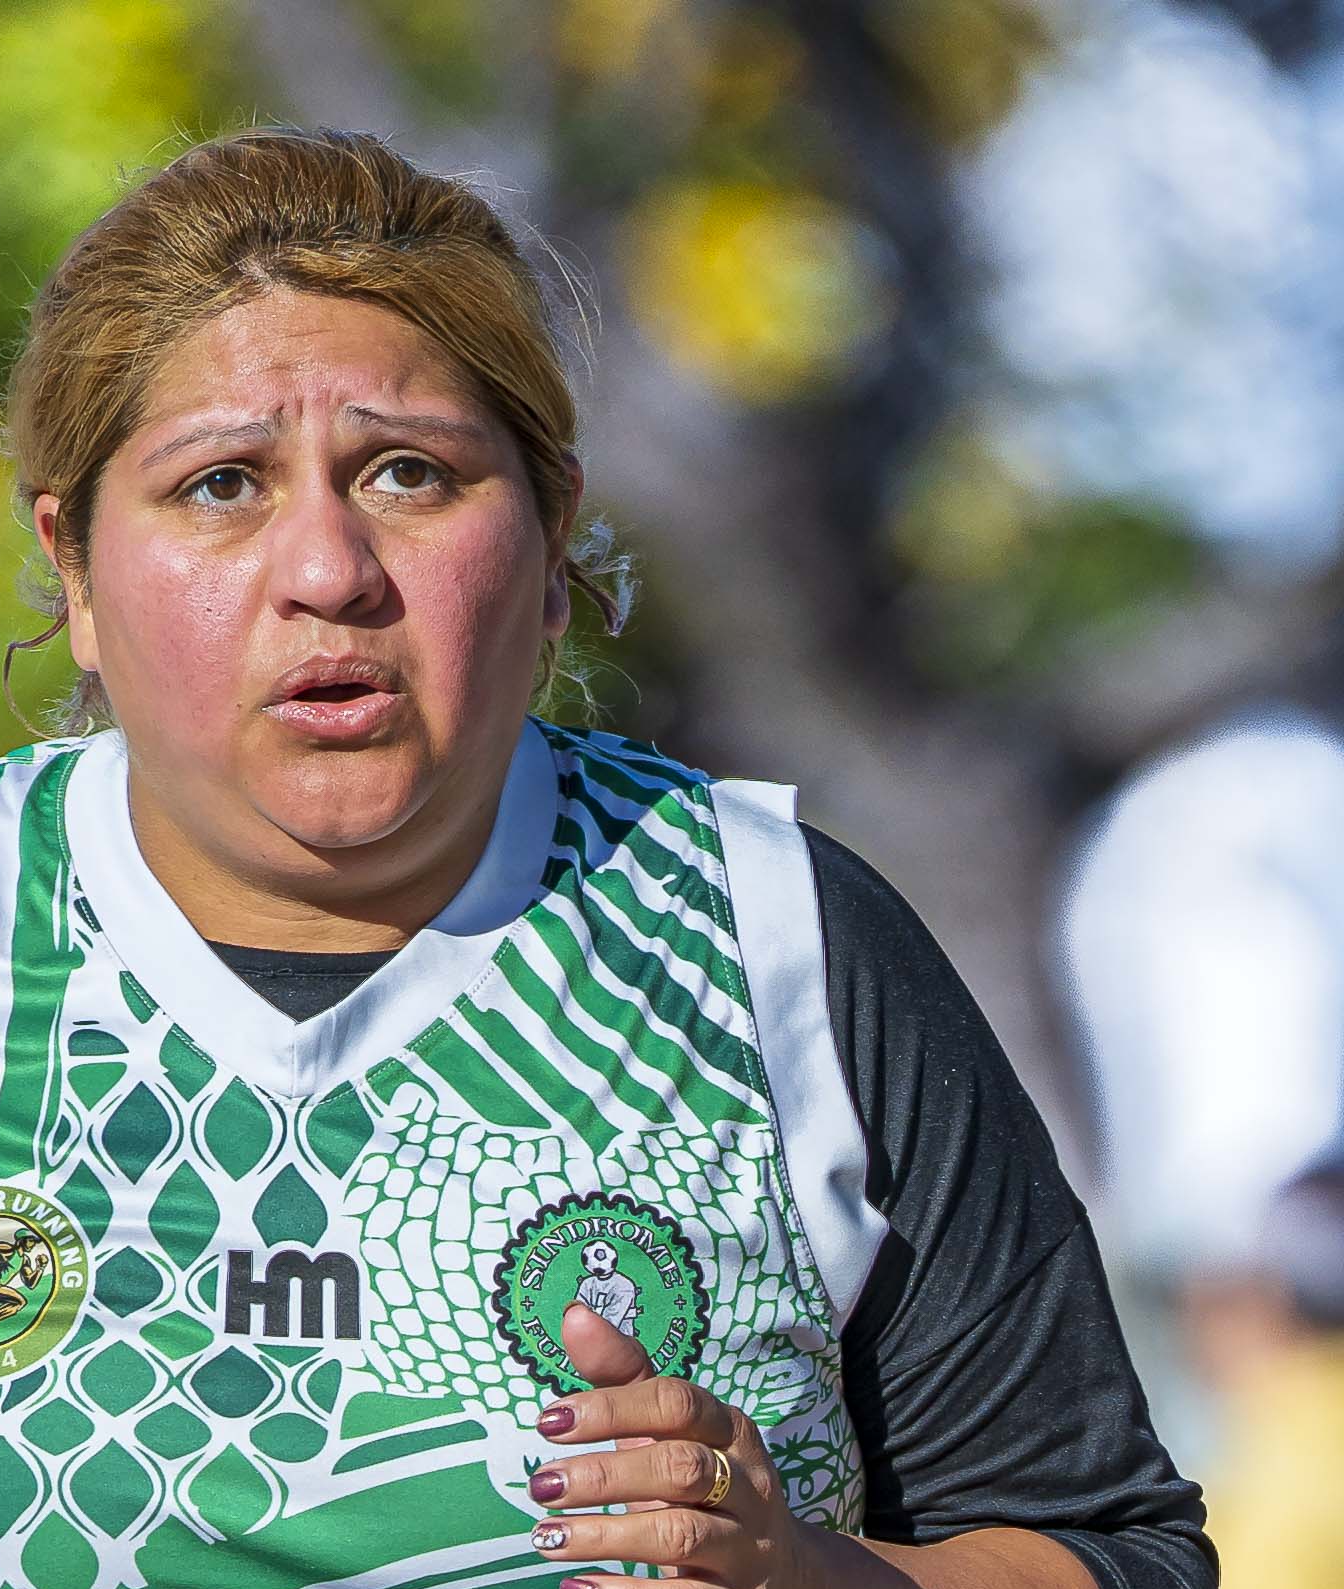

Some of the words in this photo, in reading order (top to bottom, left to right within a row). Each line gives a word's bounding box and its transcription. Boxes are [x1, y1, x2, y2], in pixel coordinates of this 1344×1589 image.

[520, 1216, 686, 1291] SINDROME
[521, 1315, 582, 1377] FUT
[649, 1316, 688, 1374] LUB
